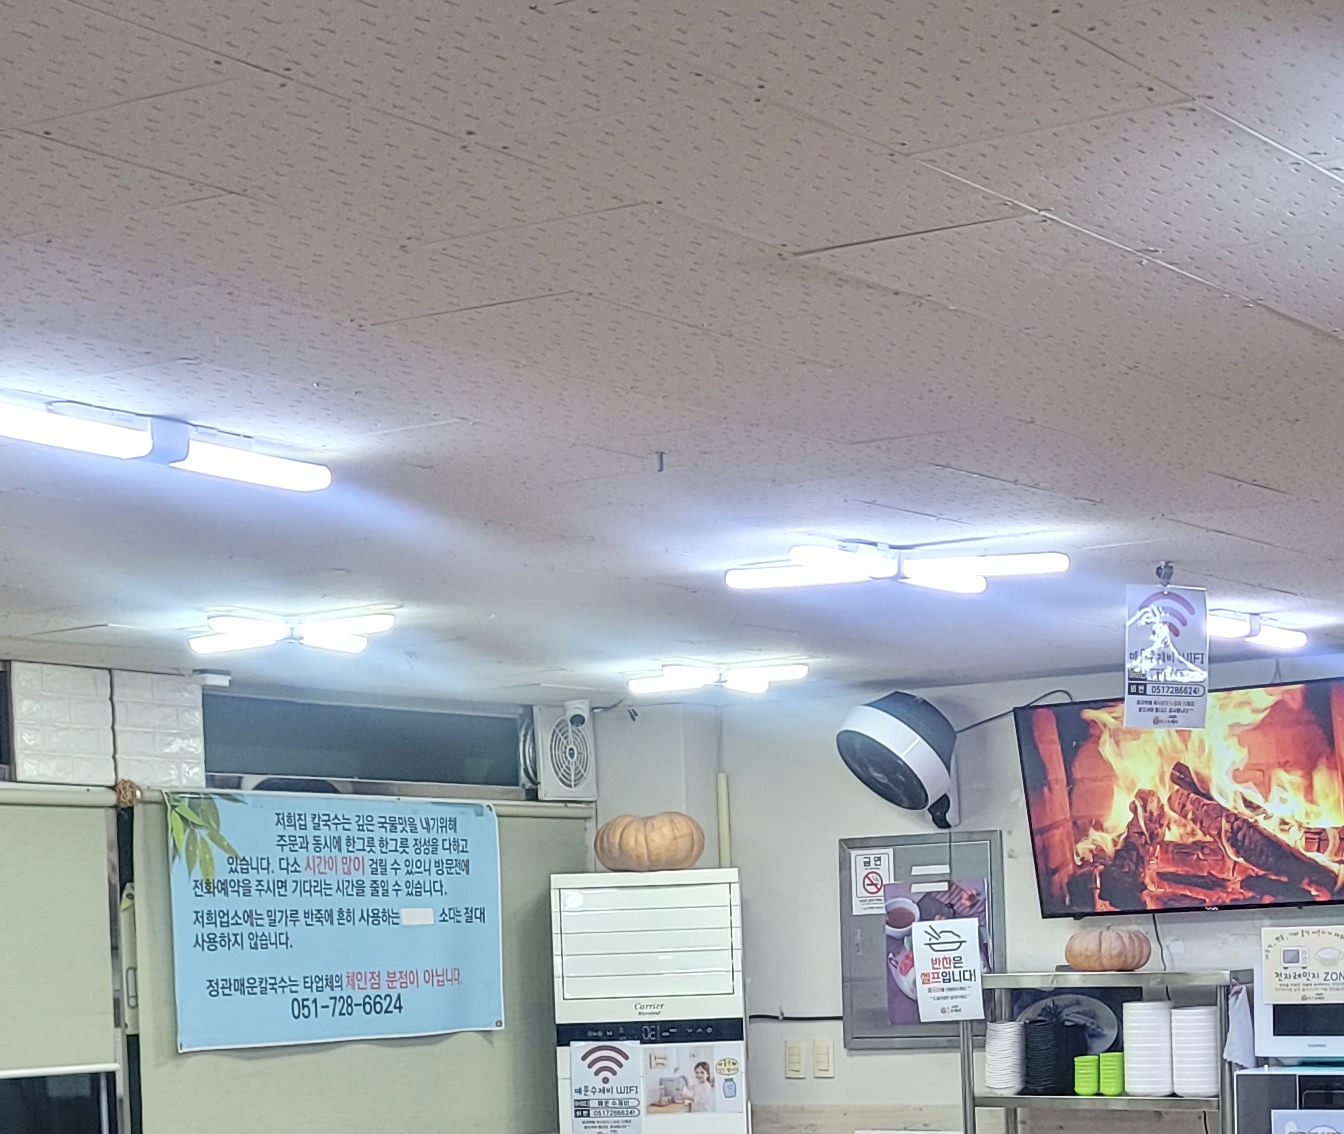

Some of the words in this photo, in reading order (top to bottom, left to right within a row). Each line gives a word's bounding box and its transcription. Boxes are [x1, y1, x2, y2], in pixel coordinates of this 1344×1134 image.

[275, 812, 307, 830] 저희집
[310, 813, 352, 832] 칼국수는
[356, 815, 375, 832] 깊은
[378, 815, 418, 834] 국물맛을
[420, 817, 457, 834] 내기위해
[276, 835, 309, 852] 주문과
[312, 835, 342, 853] 동시에
[345, 836, 376, 854] 한그릇
[379, 836, 409, 855] 한그릇
[413, 838, 439, 855] 정성을
[442, 838, 469, 854] 다하고
[227, 856, 274, 875] 있습니다.
[279, 856, 302, 875] 다소
[305, 856, 338, 875] 시간이
[341, 856, 365, 875] 많이
[369, 858, 388, 875] 걸릴
[390, 859, 402, 875] 수
[405, 859, 431, 876] 있으니
[434, 859, 469, 876] 방문전에
[863, 856, 881, 867] 금연
[193, 879, 252, 897] 전화예약을
[255, 879, 287, 897] 주시면
[292, 879, 333, 897] 기다리는
[336, 880, 366, 897] 시간을
[370, 879, 389, 897] 줄일
[392, 880, 402, 897] 수
[405, 879, 447, 897] 있습니다.
[193, 909, 264, 928] 저희업소에는
[266, 909, 301, 927] 밀가루
[304, 909, 334, 928] 반죽에
[336, 909, 356, 927] 흔히
[358, 908, 400, 926] 사용하는
[438, 908, 462, 924] 소다는
[463, 907, 486, 924] 절대
[193, 932, 244, 952] 사용하지
[248, 932, 293, 950] 않습니다.
[931, 956, 963, 970] 반찬은
[206, 975, 300, 998] 정관매운칼국수는
[303, 973, 343, 993] 타업체의
[345, 971, 380, 992] 체인점
[385, 970, 419, 988] 분점이
[423, 968, 463, 987] 아닙니다.
[921, 969, 976, 985] 셀프입니다!
[1275, 971, 1319, 982] 전자레인지
[291, 993, 404, 1020] 051-728-6624
[634, 1003, 665, 1011] Carrier
[616, 1086, 638, 1094] WIFI
